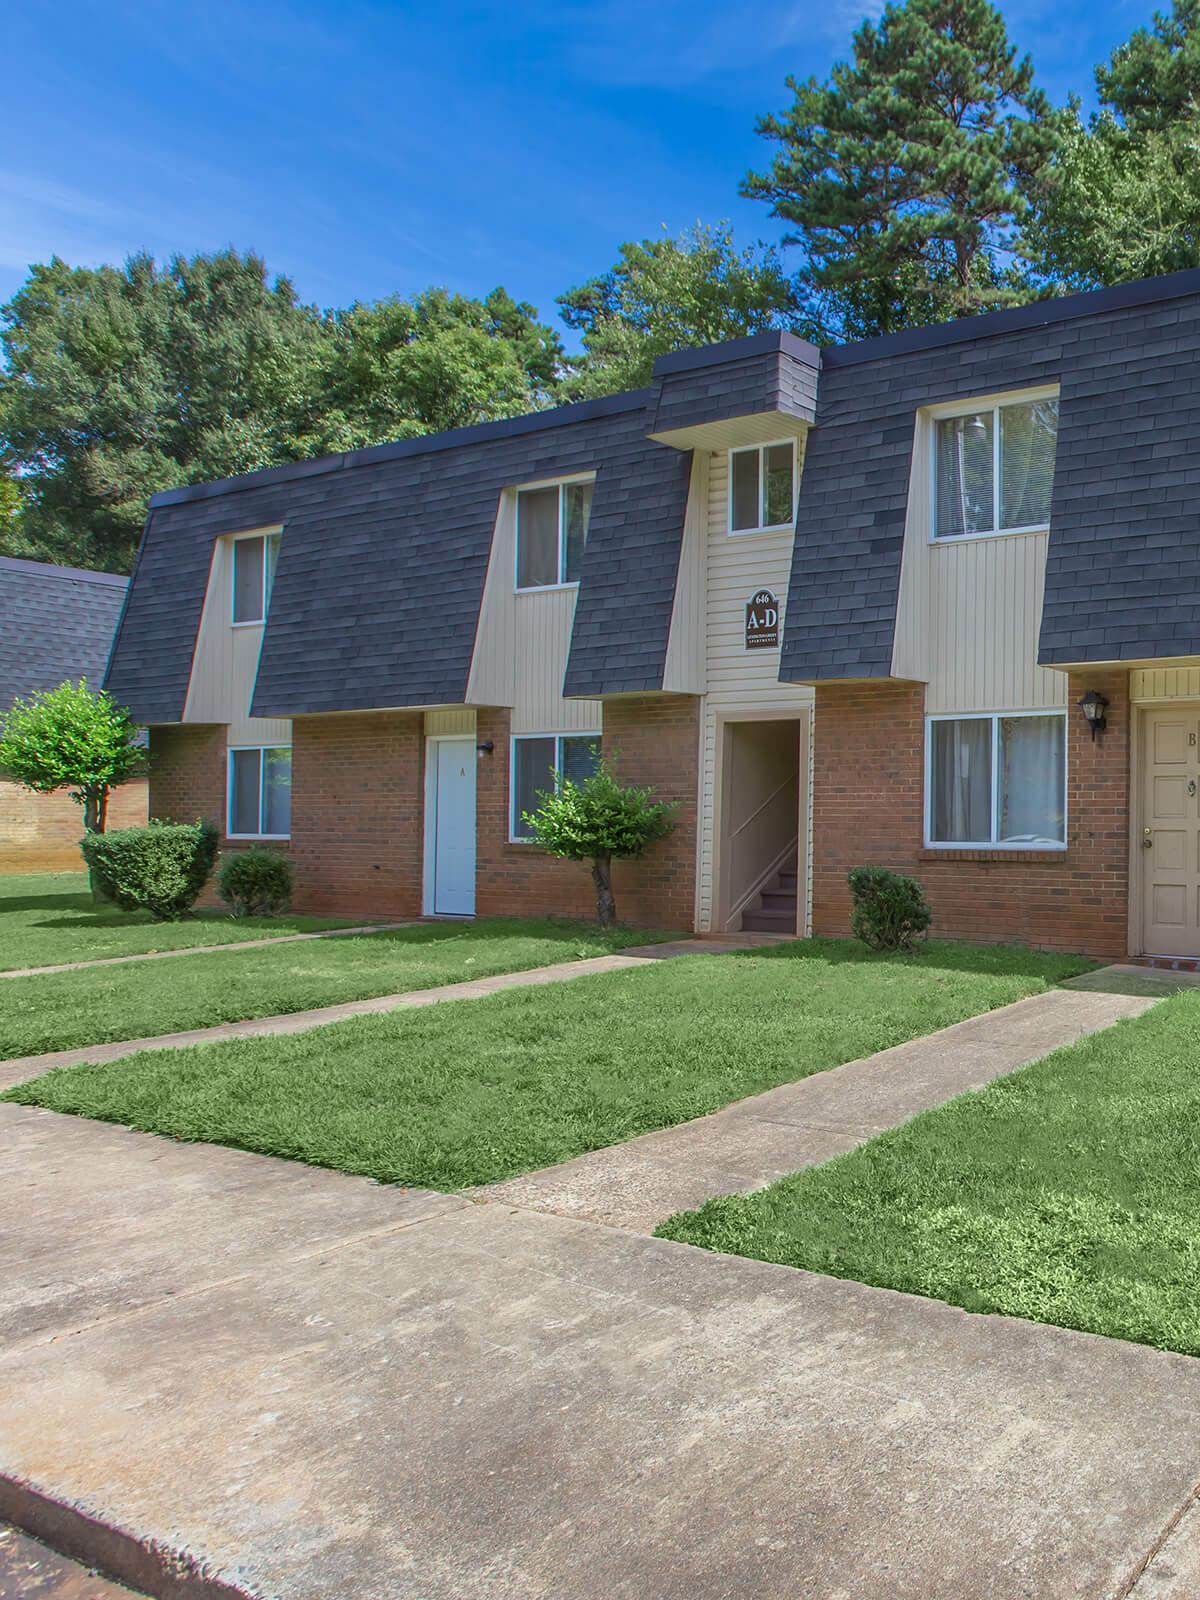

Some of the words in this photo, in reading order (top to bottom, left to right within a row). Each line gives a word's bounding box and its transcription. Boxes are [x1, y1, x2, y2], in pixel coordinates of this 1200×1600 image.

[756, 594, 769, 604] 646
[748, 608, 777, 629] A-D
[1188, 733, 1196, 745] B
[460, 767, 466, 776] A
